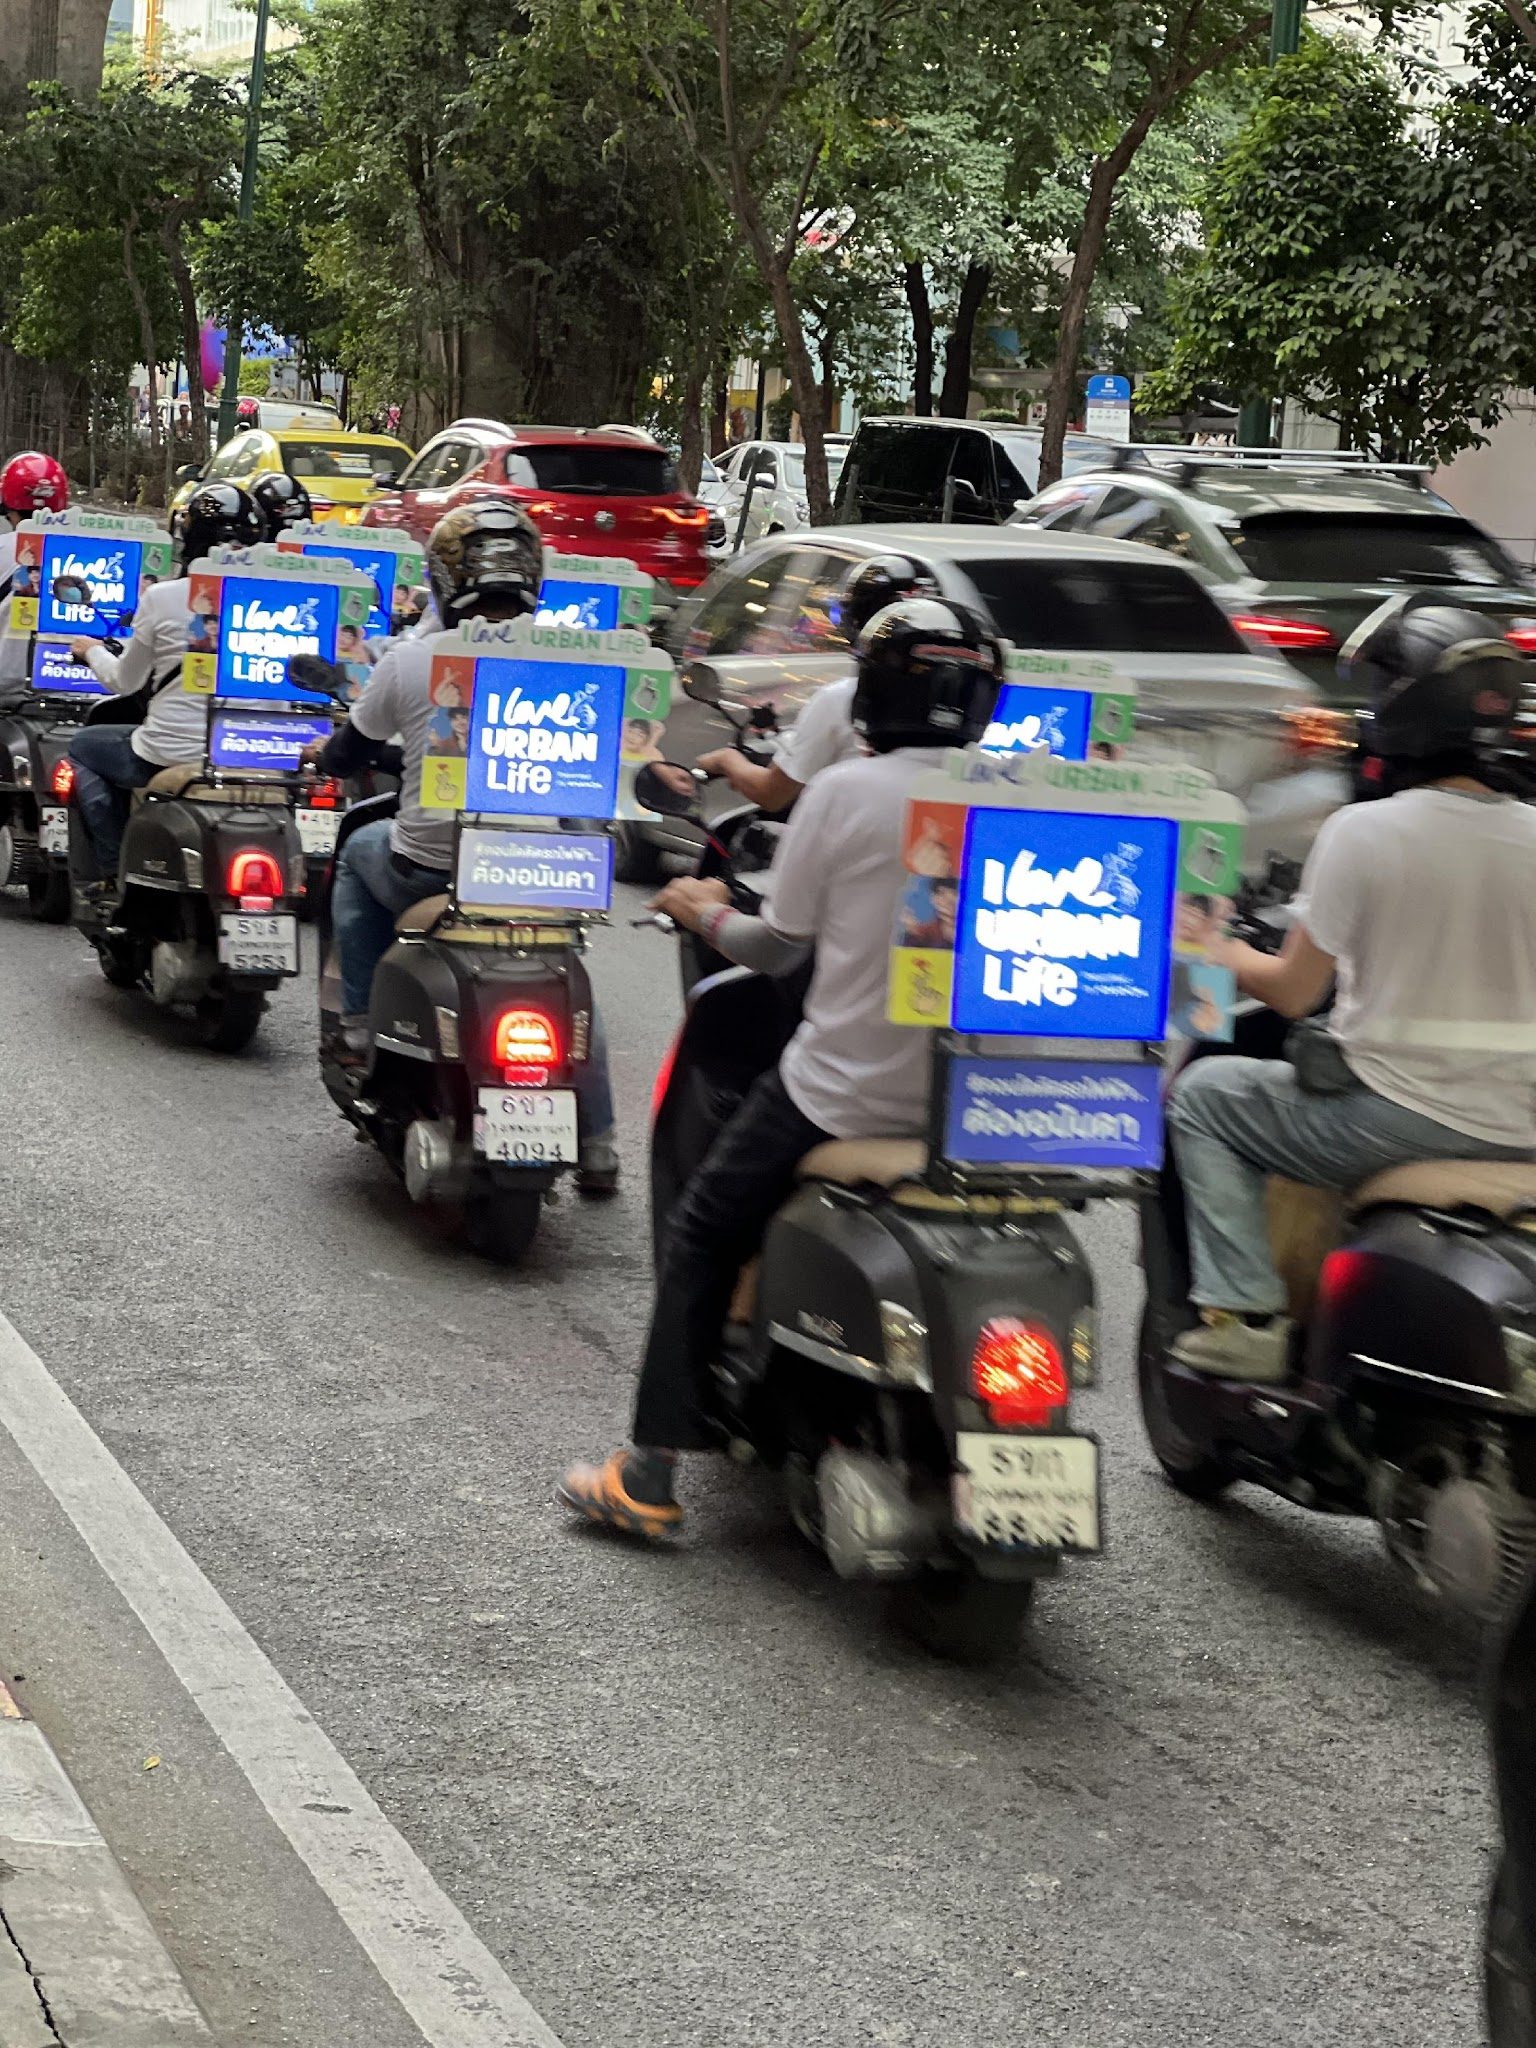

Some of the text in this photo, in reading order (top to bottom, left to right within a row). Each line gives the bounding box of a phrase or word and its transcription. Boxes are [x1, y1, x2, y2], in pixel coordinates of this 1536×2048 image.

[79, 518, 125, 530] URBAN
[51, 553, 113, 580] I love
[232, 599, 306, 632] I love
[227, 630, 320, 659] URBAN
[461, 624, 469, 643] I
[470, 620, 517, 645] love
[529, 628, 600, 651] URBAN
[232, 654, 285, 684] Life
[487, 686, 581, 728] I love
[481, 727, 599, 763] URBAN
[487, 758, 553, 795] Life
[982, 848, 1118, 908] I love
[974, 908, 1143, 961] URBAN
[982, 953, 1079, 1008] Life
[496, 1140, 564, 1162] 4094
